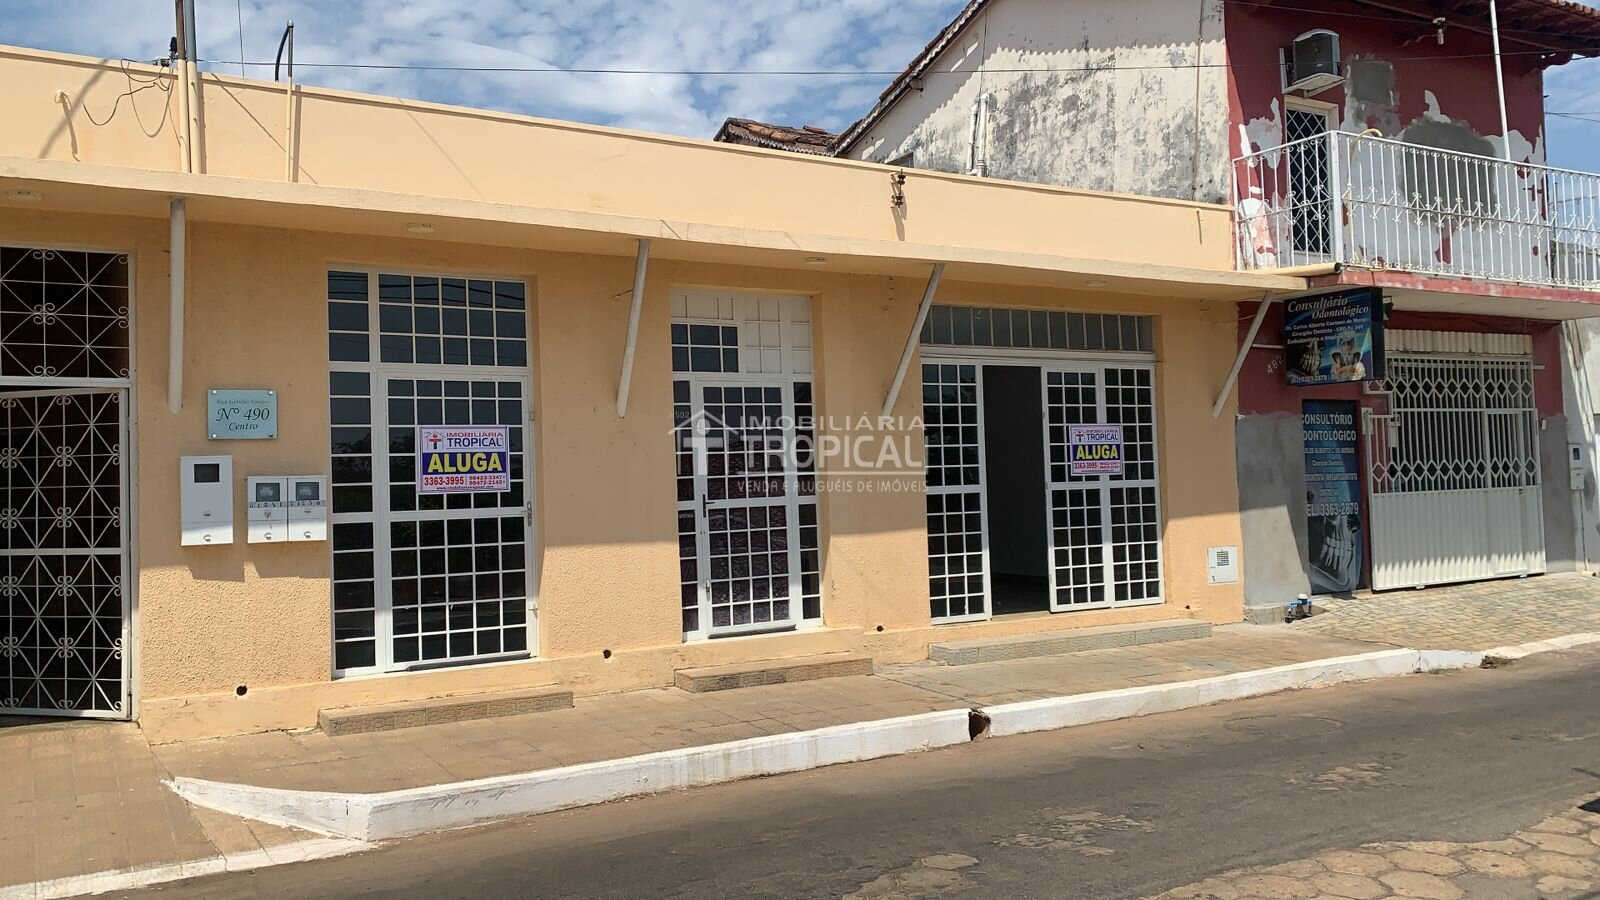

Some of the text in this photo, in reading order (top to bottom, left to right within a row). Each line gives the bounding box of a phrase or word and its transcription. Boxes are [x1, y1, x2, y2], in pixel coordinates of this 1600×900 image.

[1287, 295, 1348, 313] Consultório
[1312, 305, 1369, 320] Odontológico
[242, 407, 270, 421] 490
[228, 422, 258, 431] Centro
[447, 437, 503, 447] TROPICAL
[1086, 433, 1119, 441] TROPICAL
[1076, 444, 1119, 460] ALUGA
[427, 452, 503, 473] ALUGA
[424, 476, 464, 486] 3363-3995
[1320, 502, 1359, 517] 3363-2879
